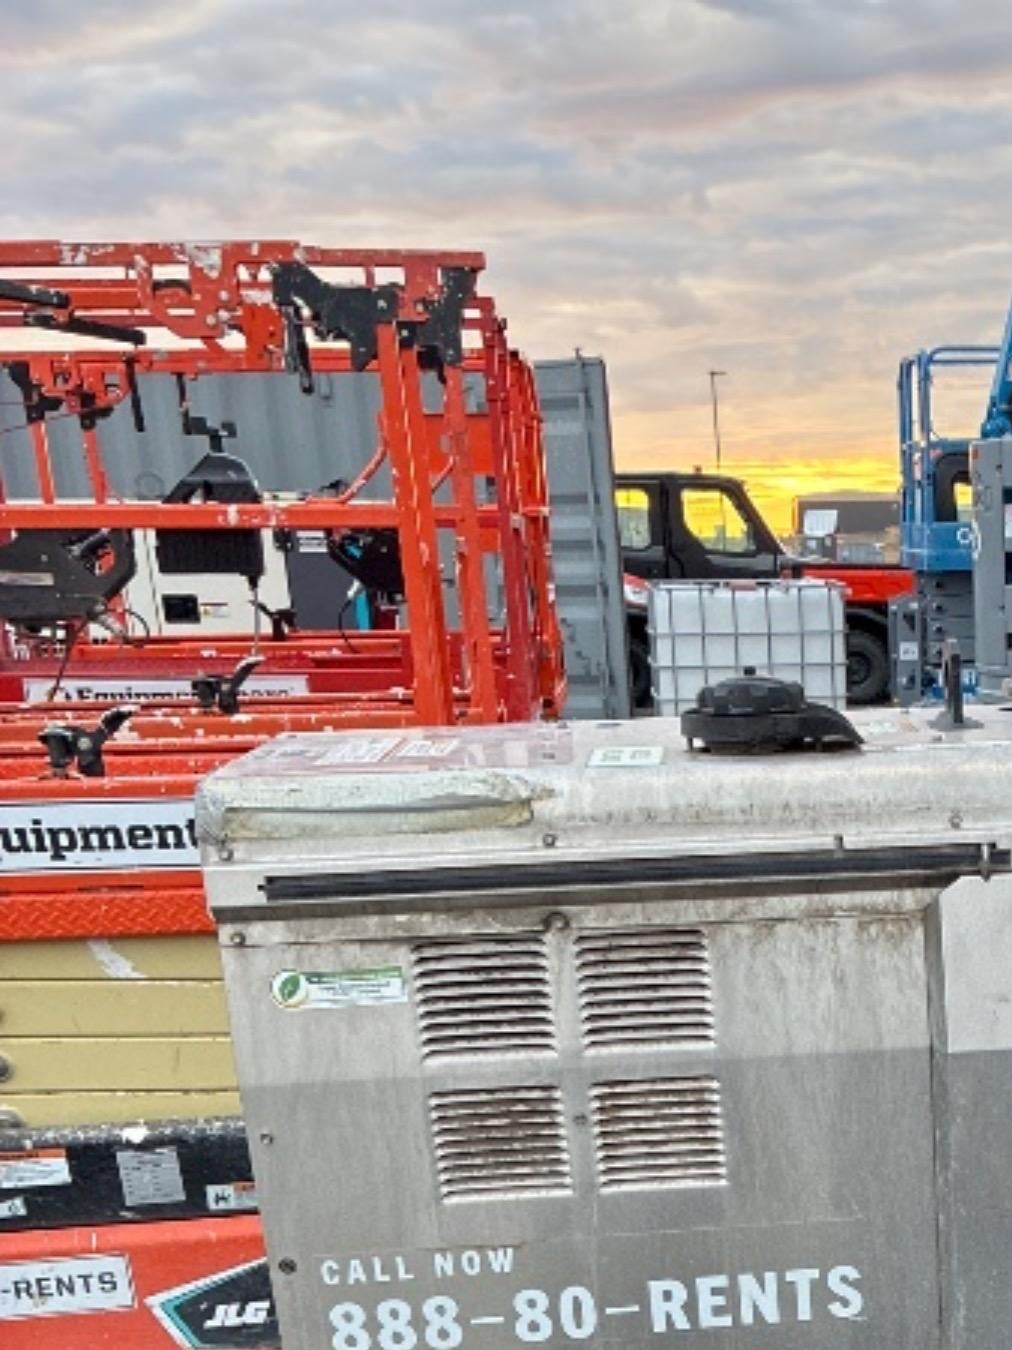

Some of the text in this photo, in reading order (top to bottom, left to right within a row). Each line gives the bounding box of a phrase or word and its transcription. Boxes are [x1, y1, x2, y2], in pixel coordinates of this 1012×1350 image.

[0, 819, 198, 861] uipment
[320, 1247, 515, 1285] CALL NOW
[203, 1299, 271, 1329] JLG
